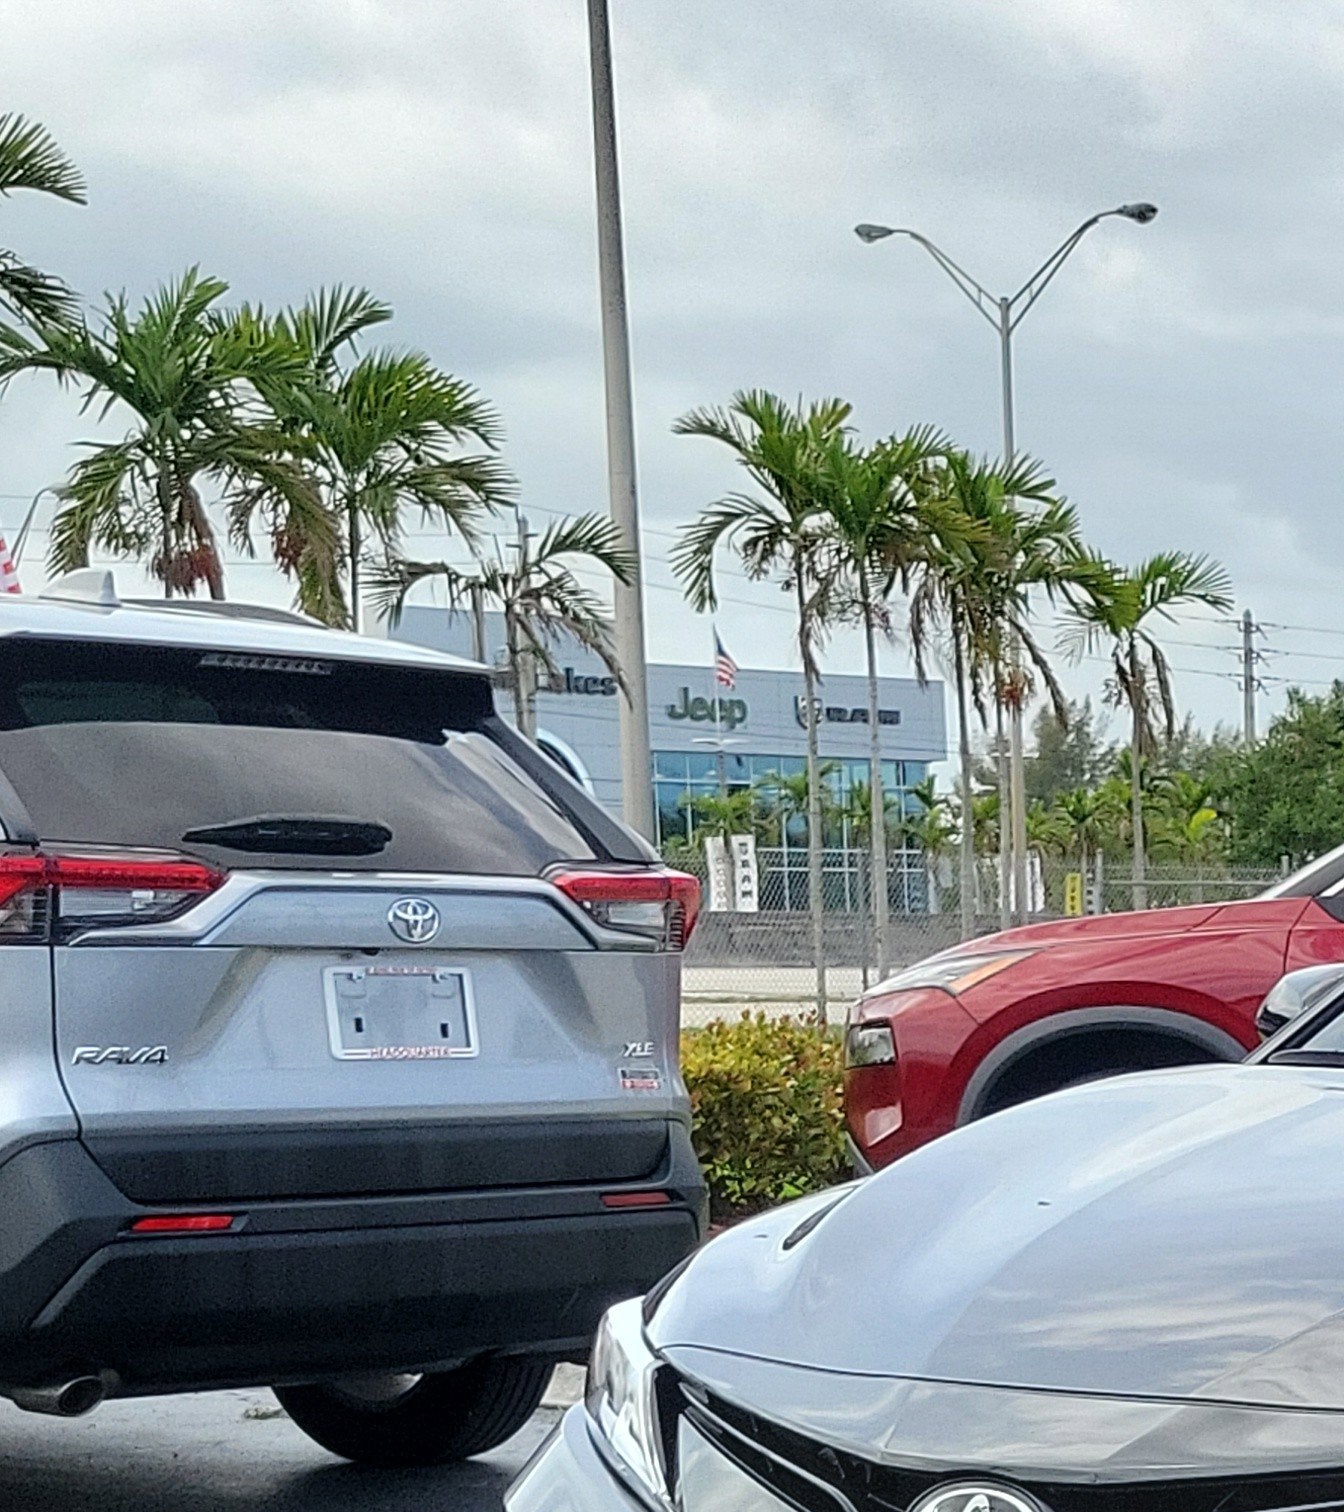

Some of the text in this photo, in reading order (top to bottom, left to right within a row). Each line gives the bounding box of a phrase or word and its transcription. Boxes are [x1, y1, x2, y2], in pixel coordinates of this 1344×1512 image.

[668, 686, 748, 731] Jeep
[826, 707, 900, 725] RAM
[71, 1045, 170, 1066] RAV4
